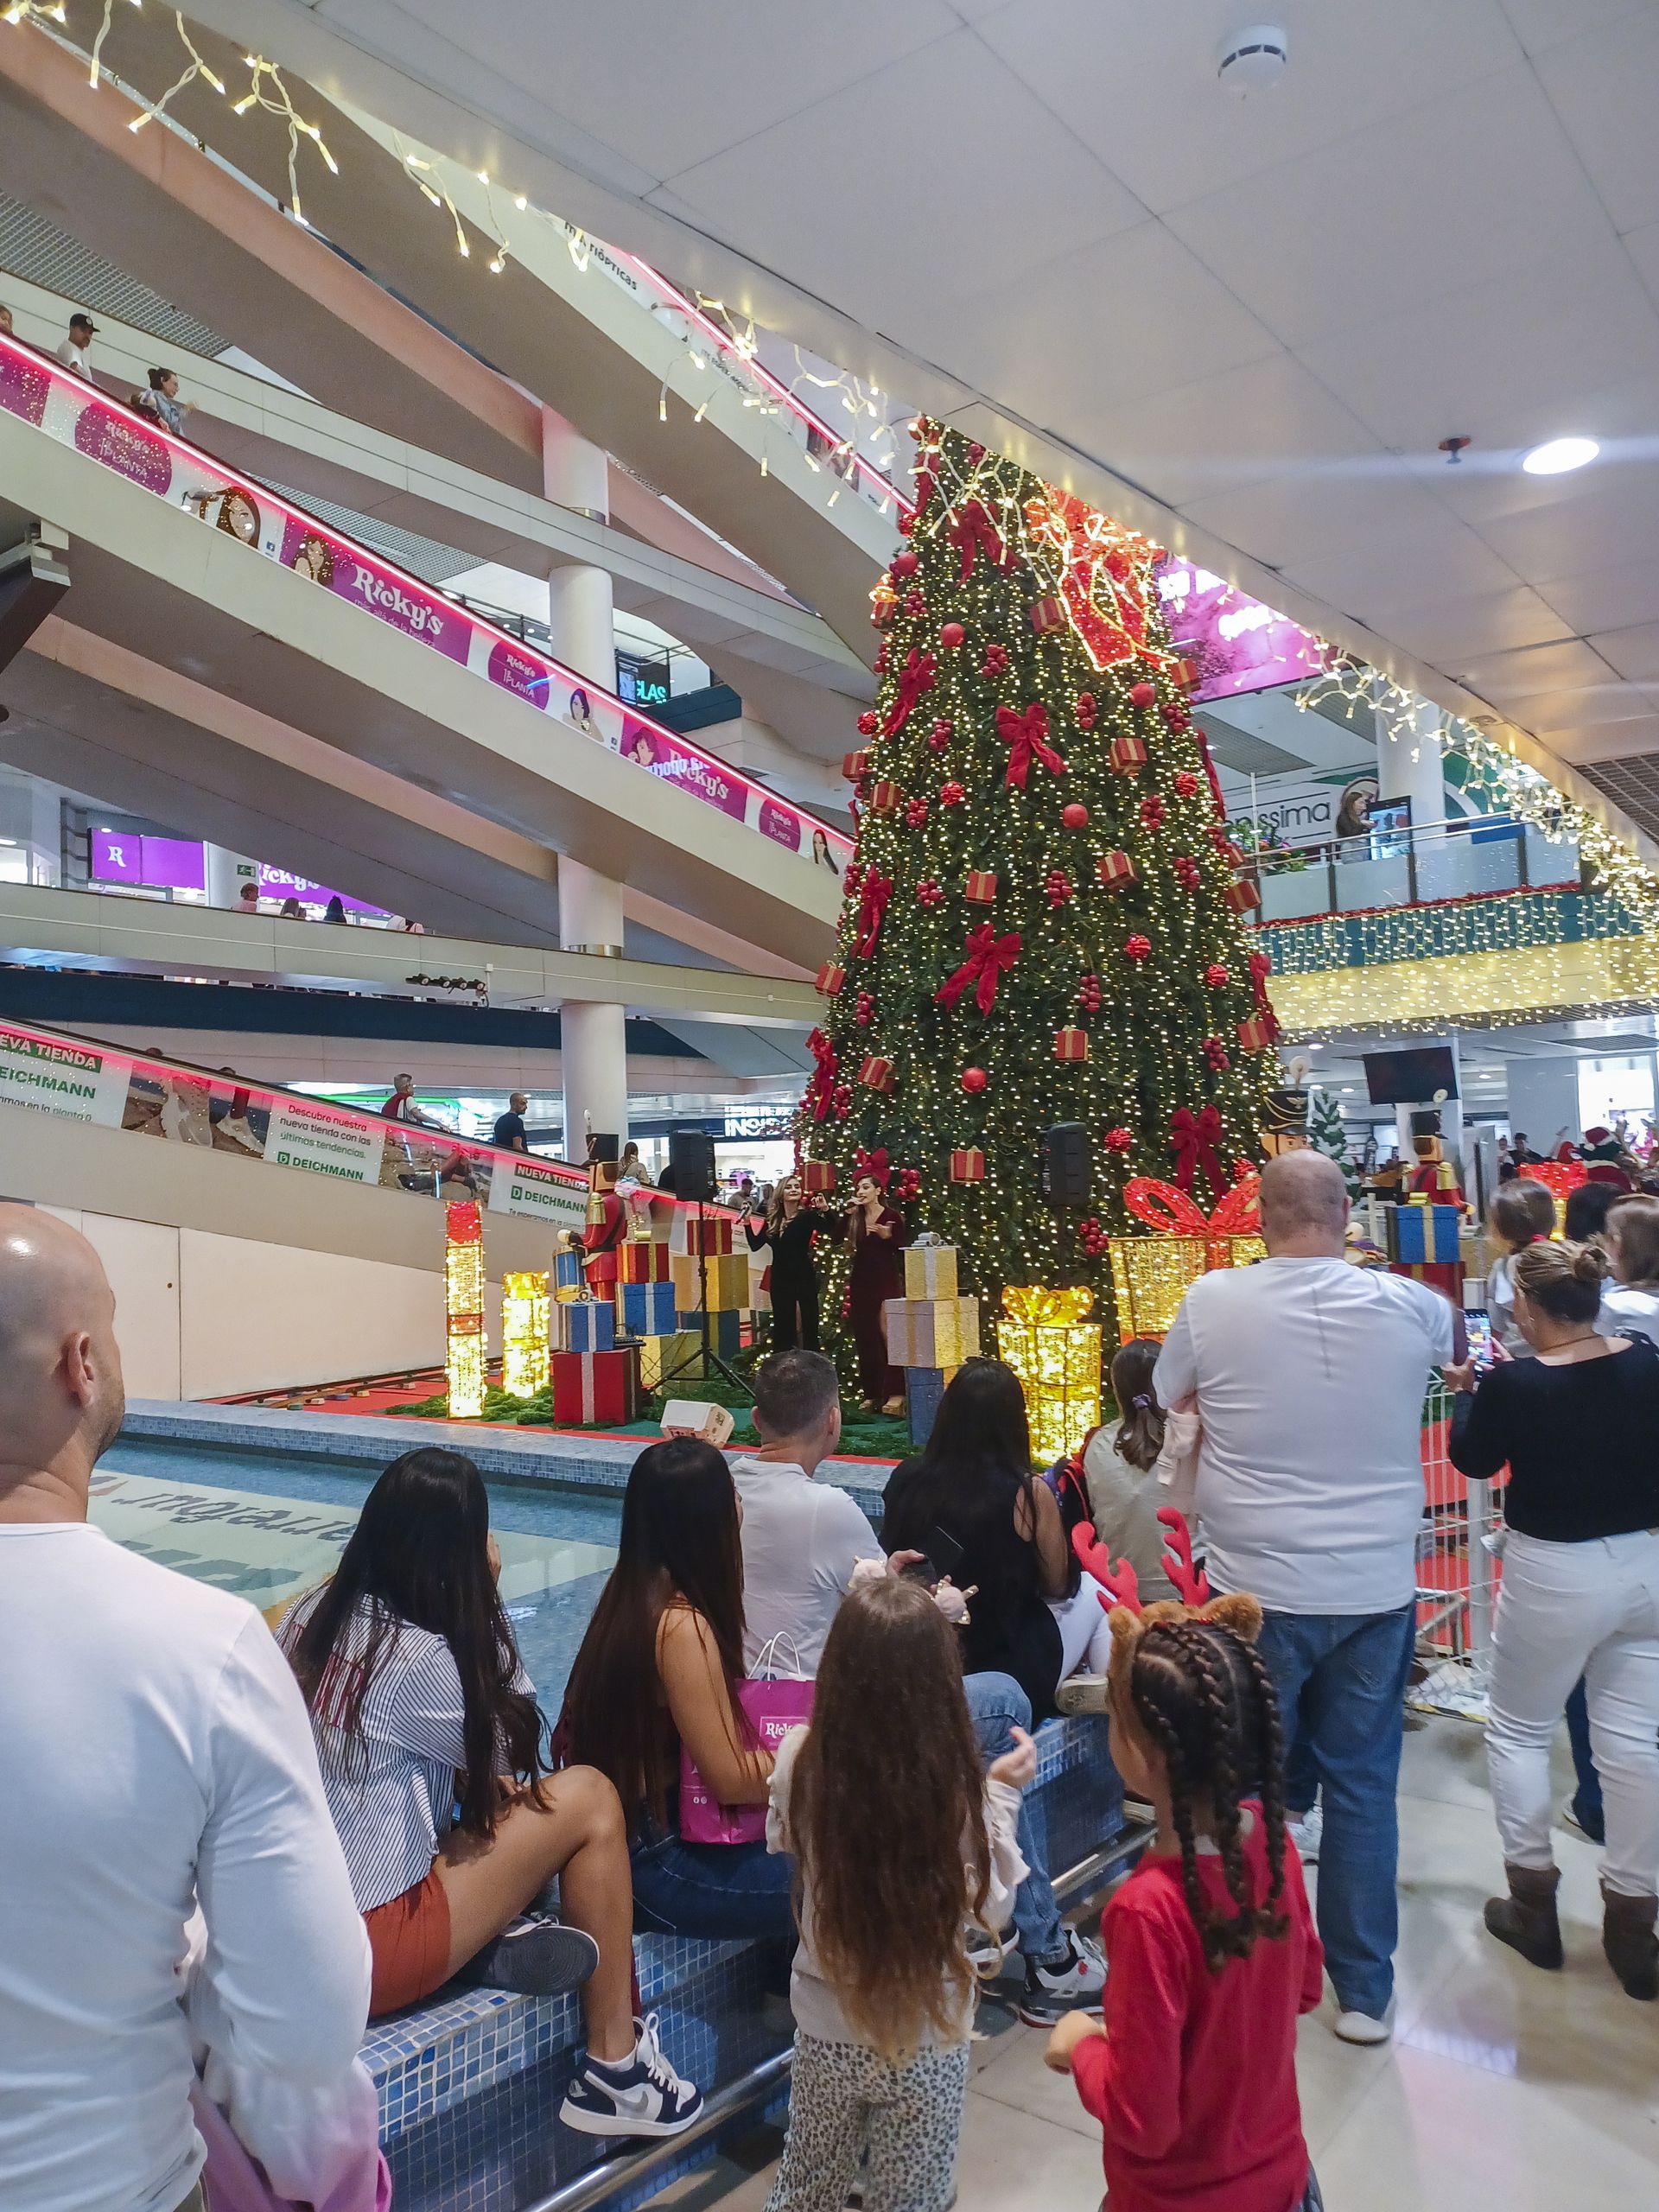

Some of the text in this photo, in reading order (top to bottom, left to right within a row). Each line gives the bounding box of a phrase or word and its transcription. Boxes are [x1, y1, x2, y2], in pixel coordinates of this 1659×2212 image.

[351, 564, 444, 635] Ricky's
[107, 846, 127, 868] R
[36, 1043, 97, 1070] TIENDA
[288, 1104, 367, 1133] Descubre nuestra
[279, 1117, 371, 1146] nueva tienda con las
[280, 1131, 315, 1147] últimas
[292, 1157, 364, 1180] DEICHMANN
[518, 1165, 551, 1183] NUEVA
